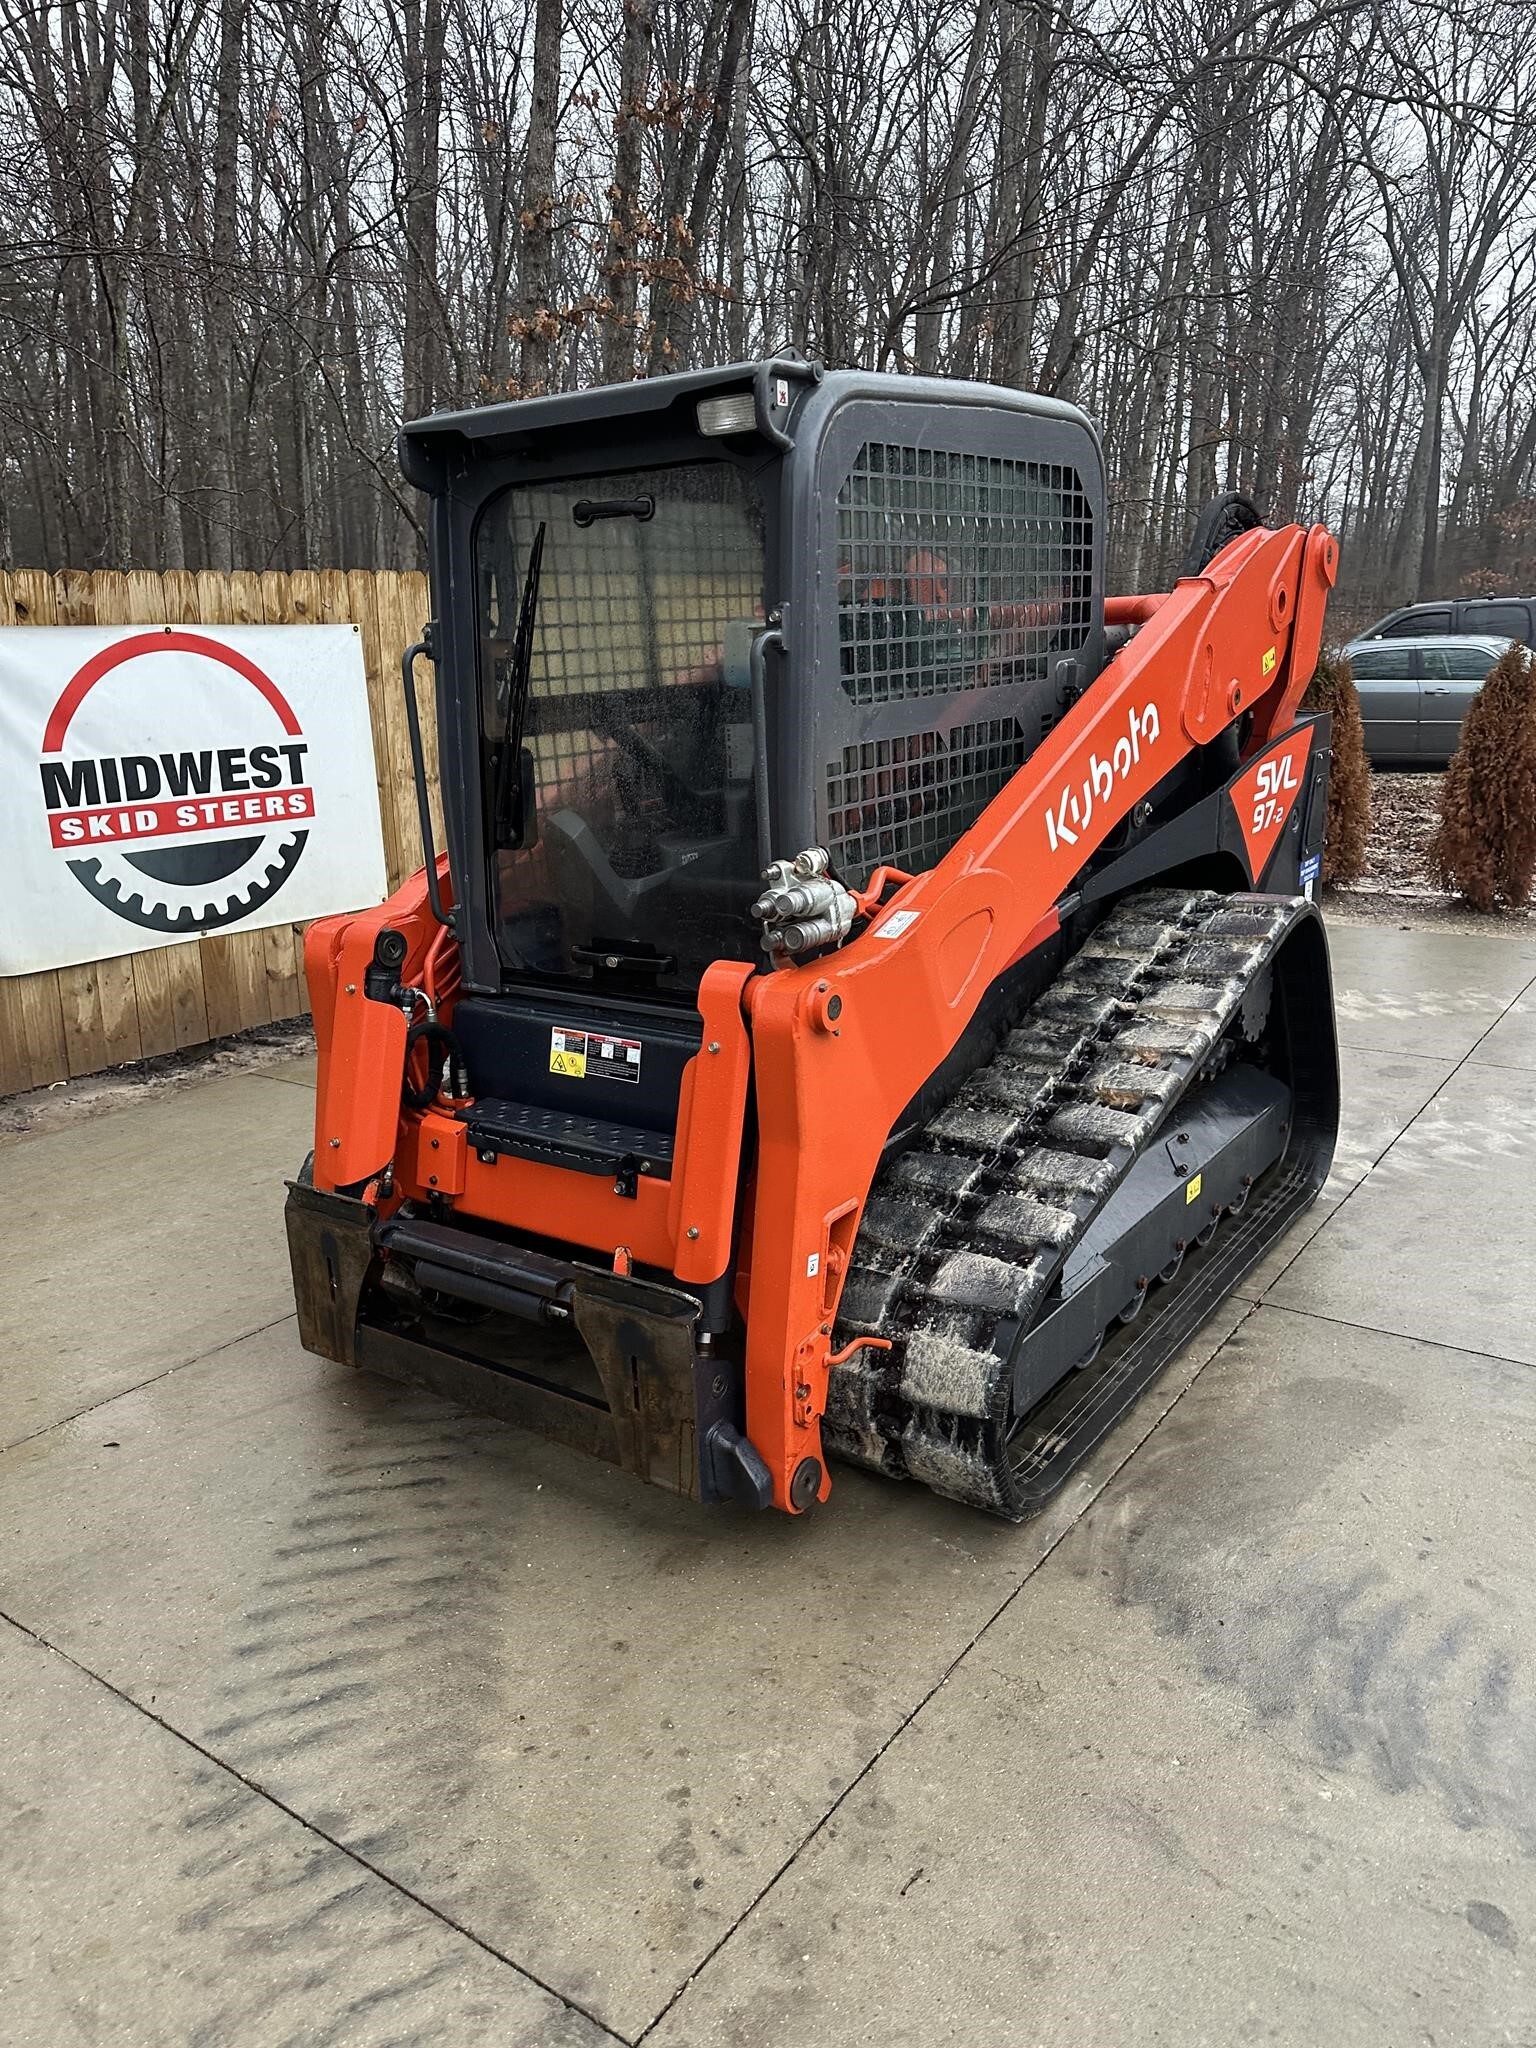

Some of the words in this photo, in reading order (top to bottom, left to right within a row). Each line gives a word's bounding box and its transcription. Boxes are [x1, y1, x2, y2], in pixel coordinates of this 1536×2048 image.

[39, 743, 308, 810] MIDWEST
[1045, 702, 1160, 853] Kubota
[1253, 754, 1298, 802] SVL
[59, 810, 158, 841] SKID
[176, 793, 308, 827] STEERS
[1251, 798, 1284, 835] 97-2
